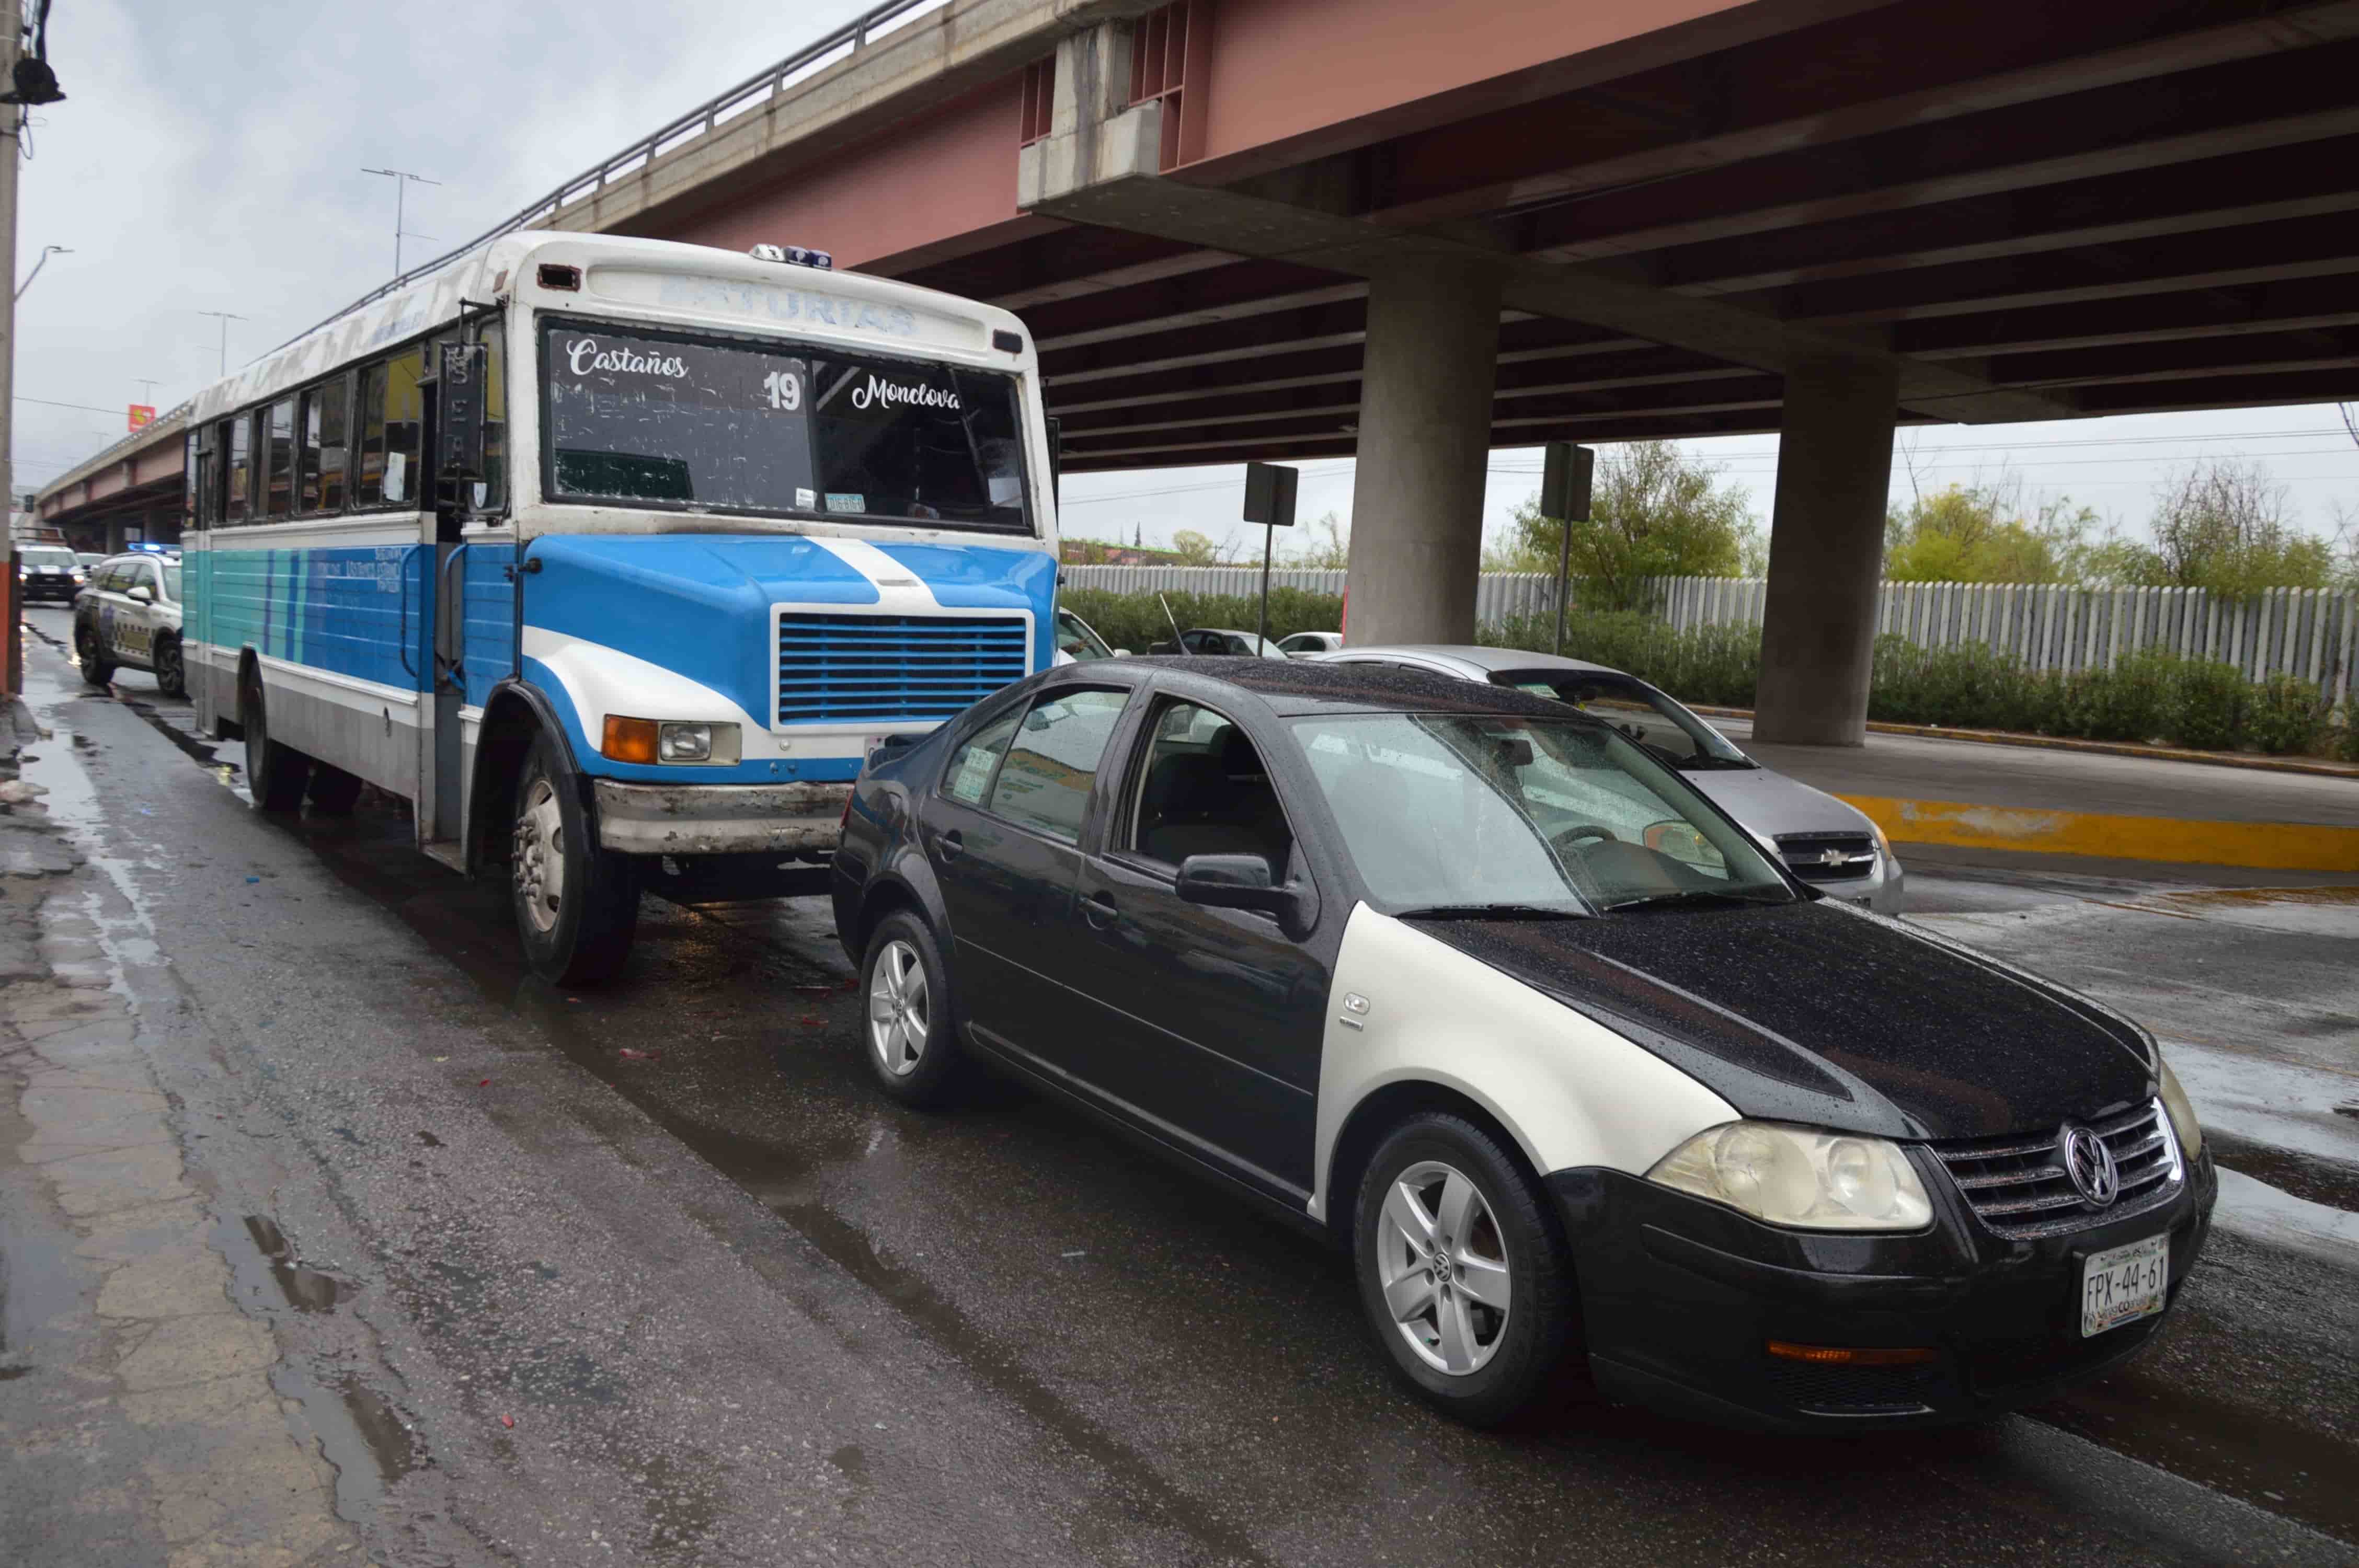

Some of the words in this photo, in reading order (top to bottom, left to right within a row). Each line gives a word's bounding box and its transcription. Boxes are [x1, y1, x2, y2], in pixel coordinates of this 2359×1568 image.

[566, 339, 689, 378] Castaños
[764, 372, 800, 411] 19
[851, 374, 960, 409] Monclova
[2087, 1256, 2164, 1311] FPX-44-61
